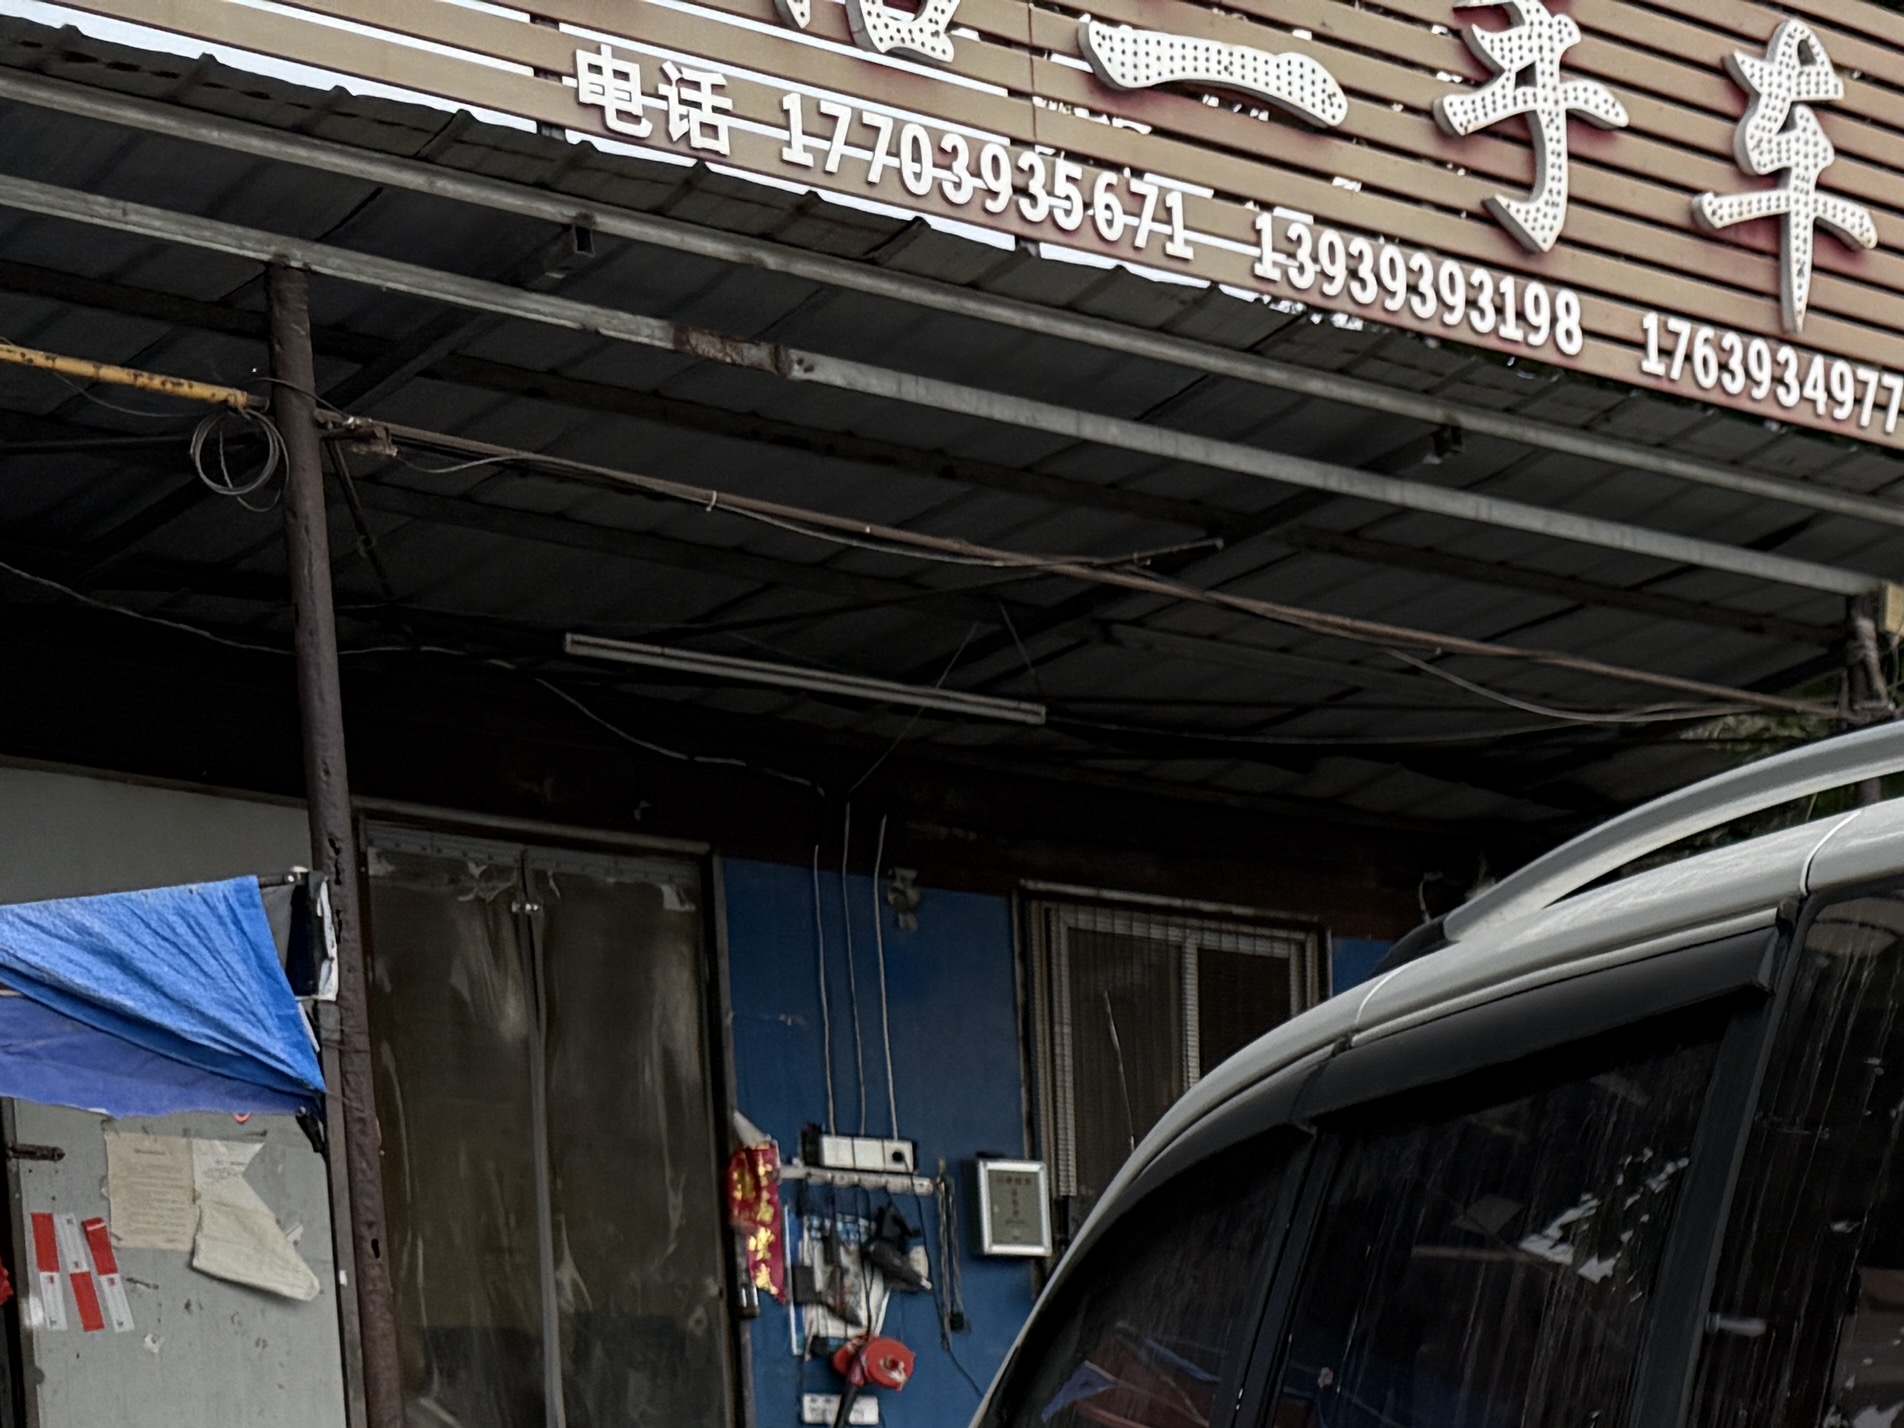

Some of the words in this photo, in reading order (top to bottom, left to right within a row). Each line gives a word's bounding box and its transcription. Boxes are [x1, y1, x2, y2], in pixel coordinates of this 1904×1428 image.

[576, 44, 733, 156] 电话
[780, 92, 1194, 261] 17703935671
[1253, 212, 1583, 357] 13939393198
